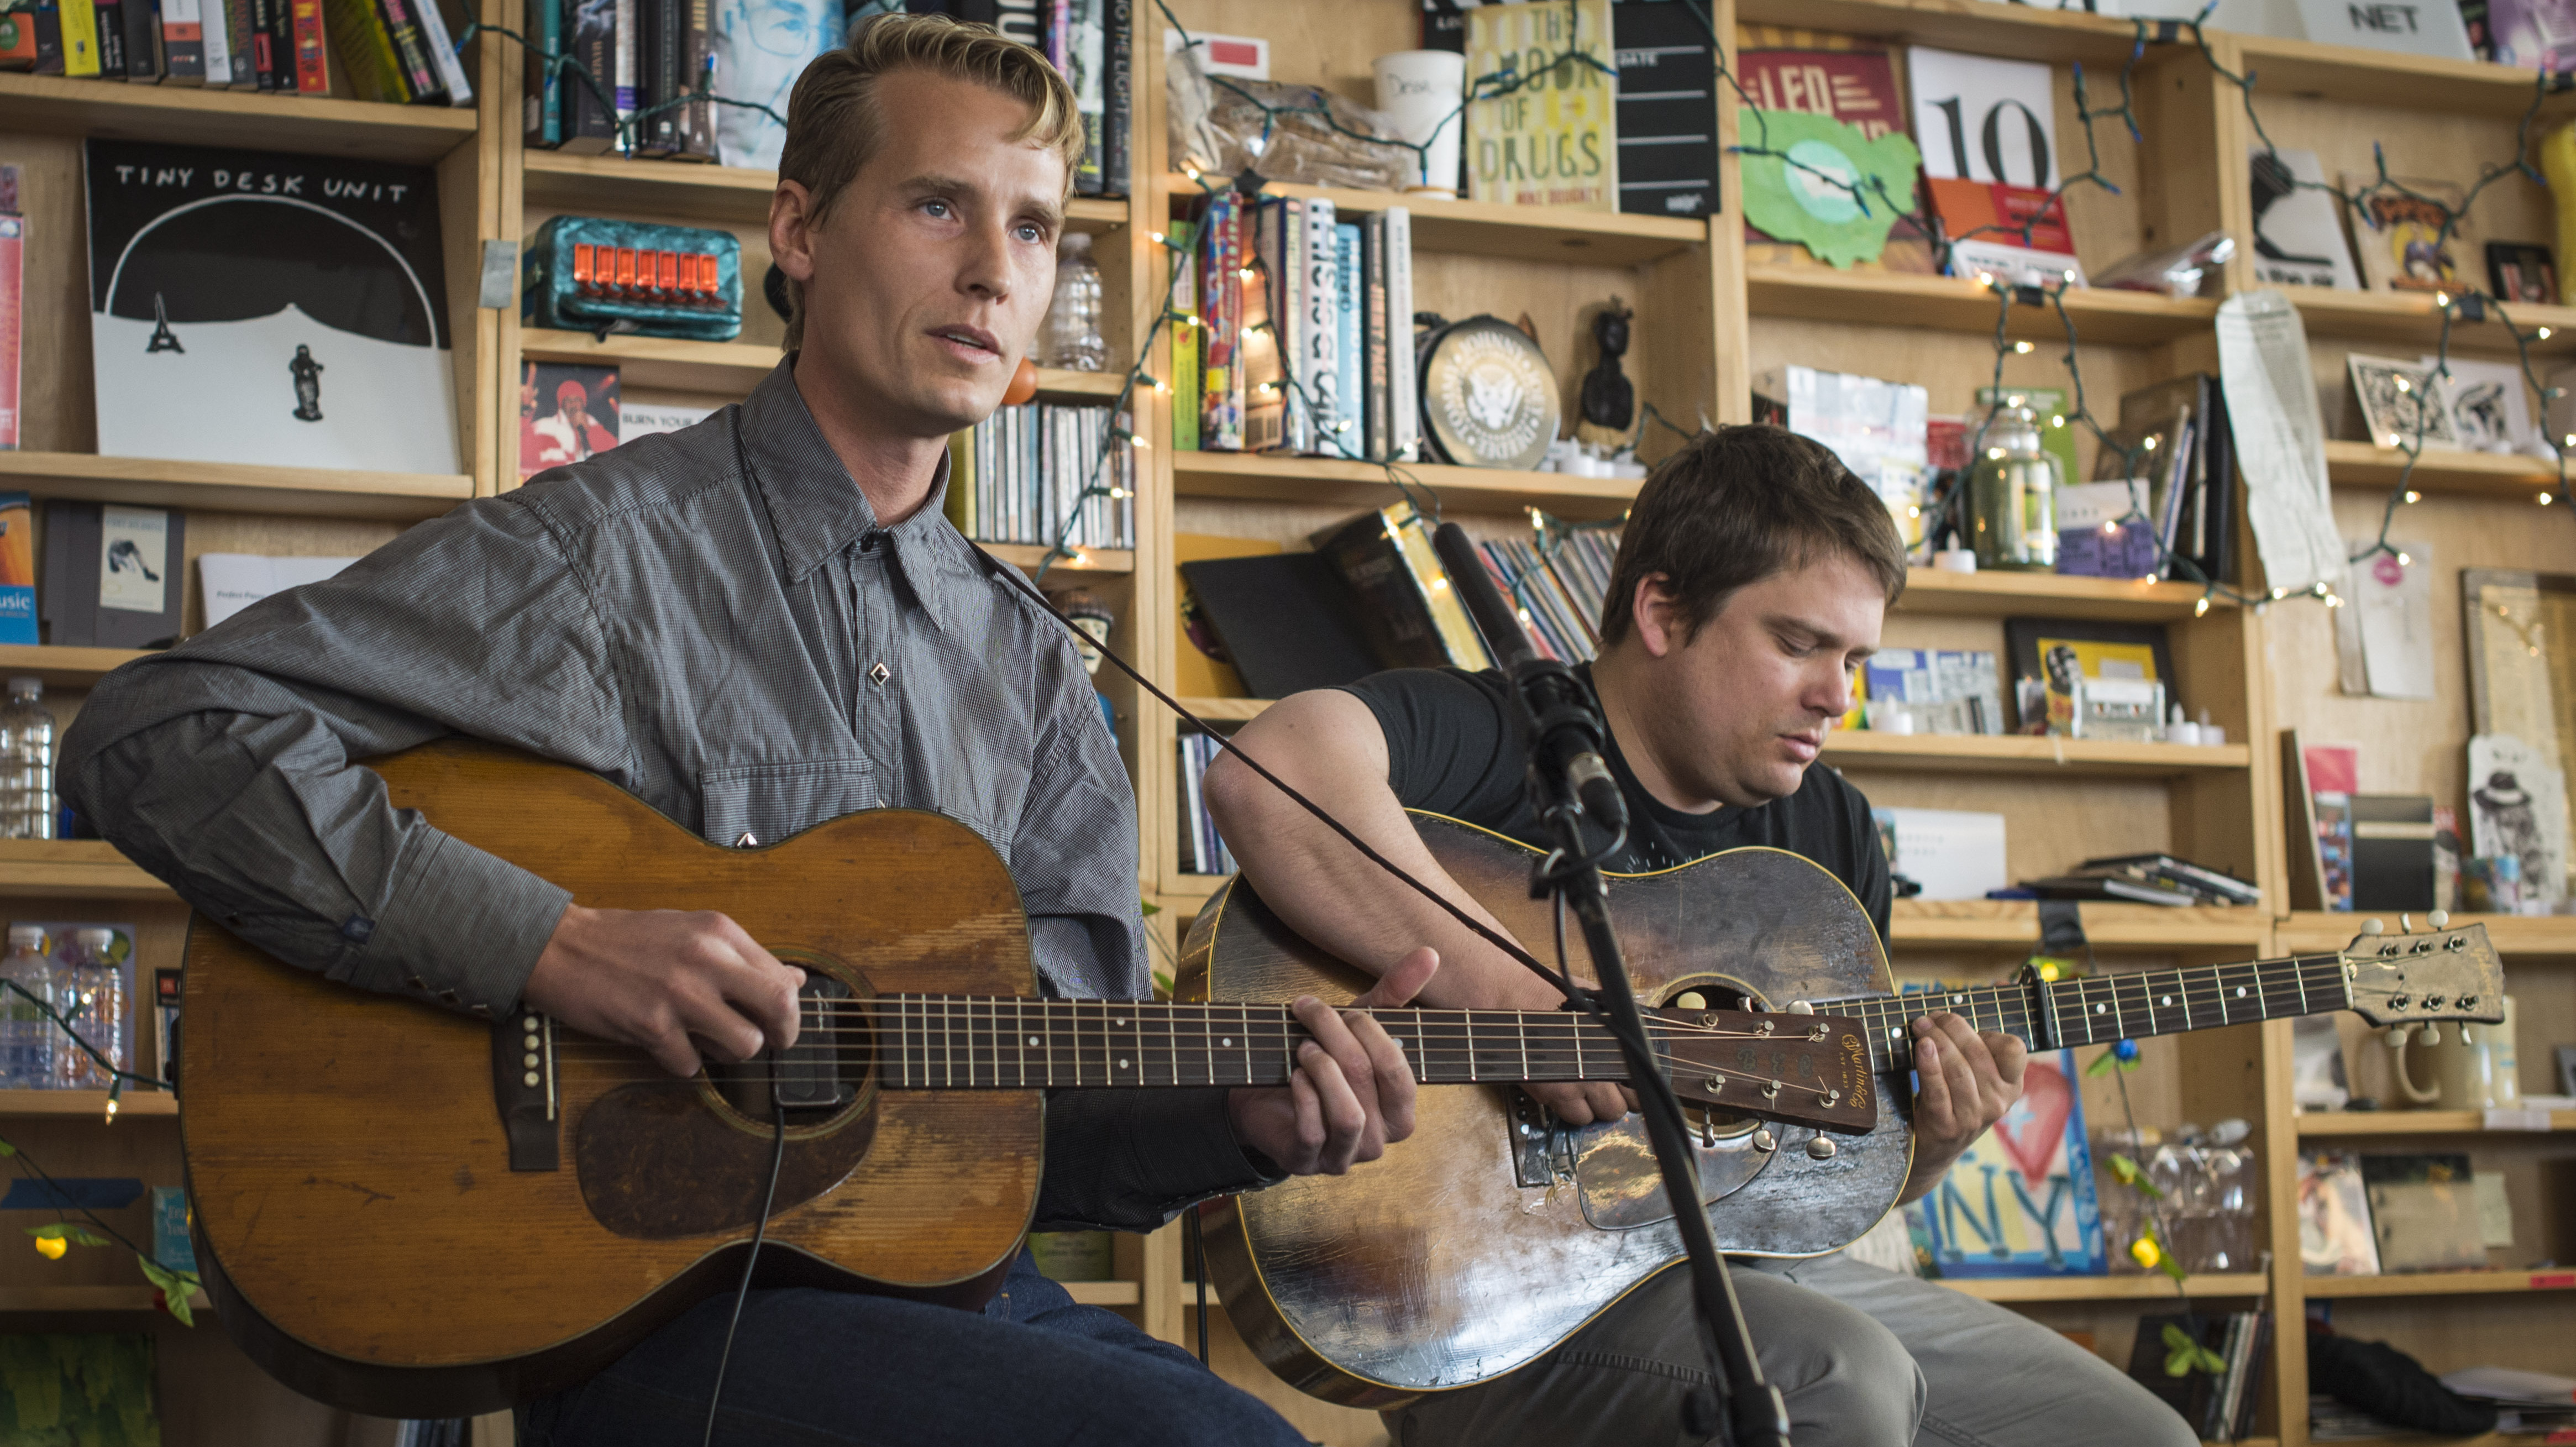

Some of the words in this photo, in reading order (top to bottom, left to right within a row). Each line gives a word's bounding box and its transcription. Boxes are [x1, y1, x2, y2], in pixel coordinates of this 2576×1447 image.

[2349, 3, 2420, 34] NET
[1114, 25, 1131, 57] THE
[1113, 59, 1131, 114] LIGHT
[1501, 97, 1529, 131] OF
[1478, 132, 1602, 183] DRUGS
[1924, 94, 2052, 190] 10
[115, 165, 194, 188] TINY
[213, 169, 305, 195] DESK
[323, 179, 408, 204] UNIT
[1370, 283, 1386, 339] JIMMY
[1371, 344, 1387, 388] PAGE
[622, 412, 655, 425] BURN
[659, 415, 692, 427] YOUR
[1940, 1163, 2070, 1271] NY
